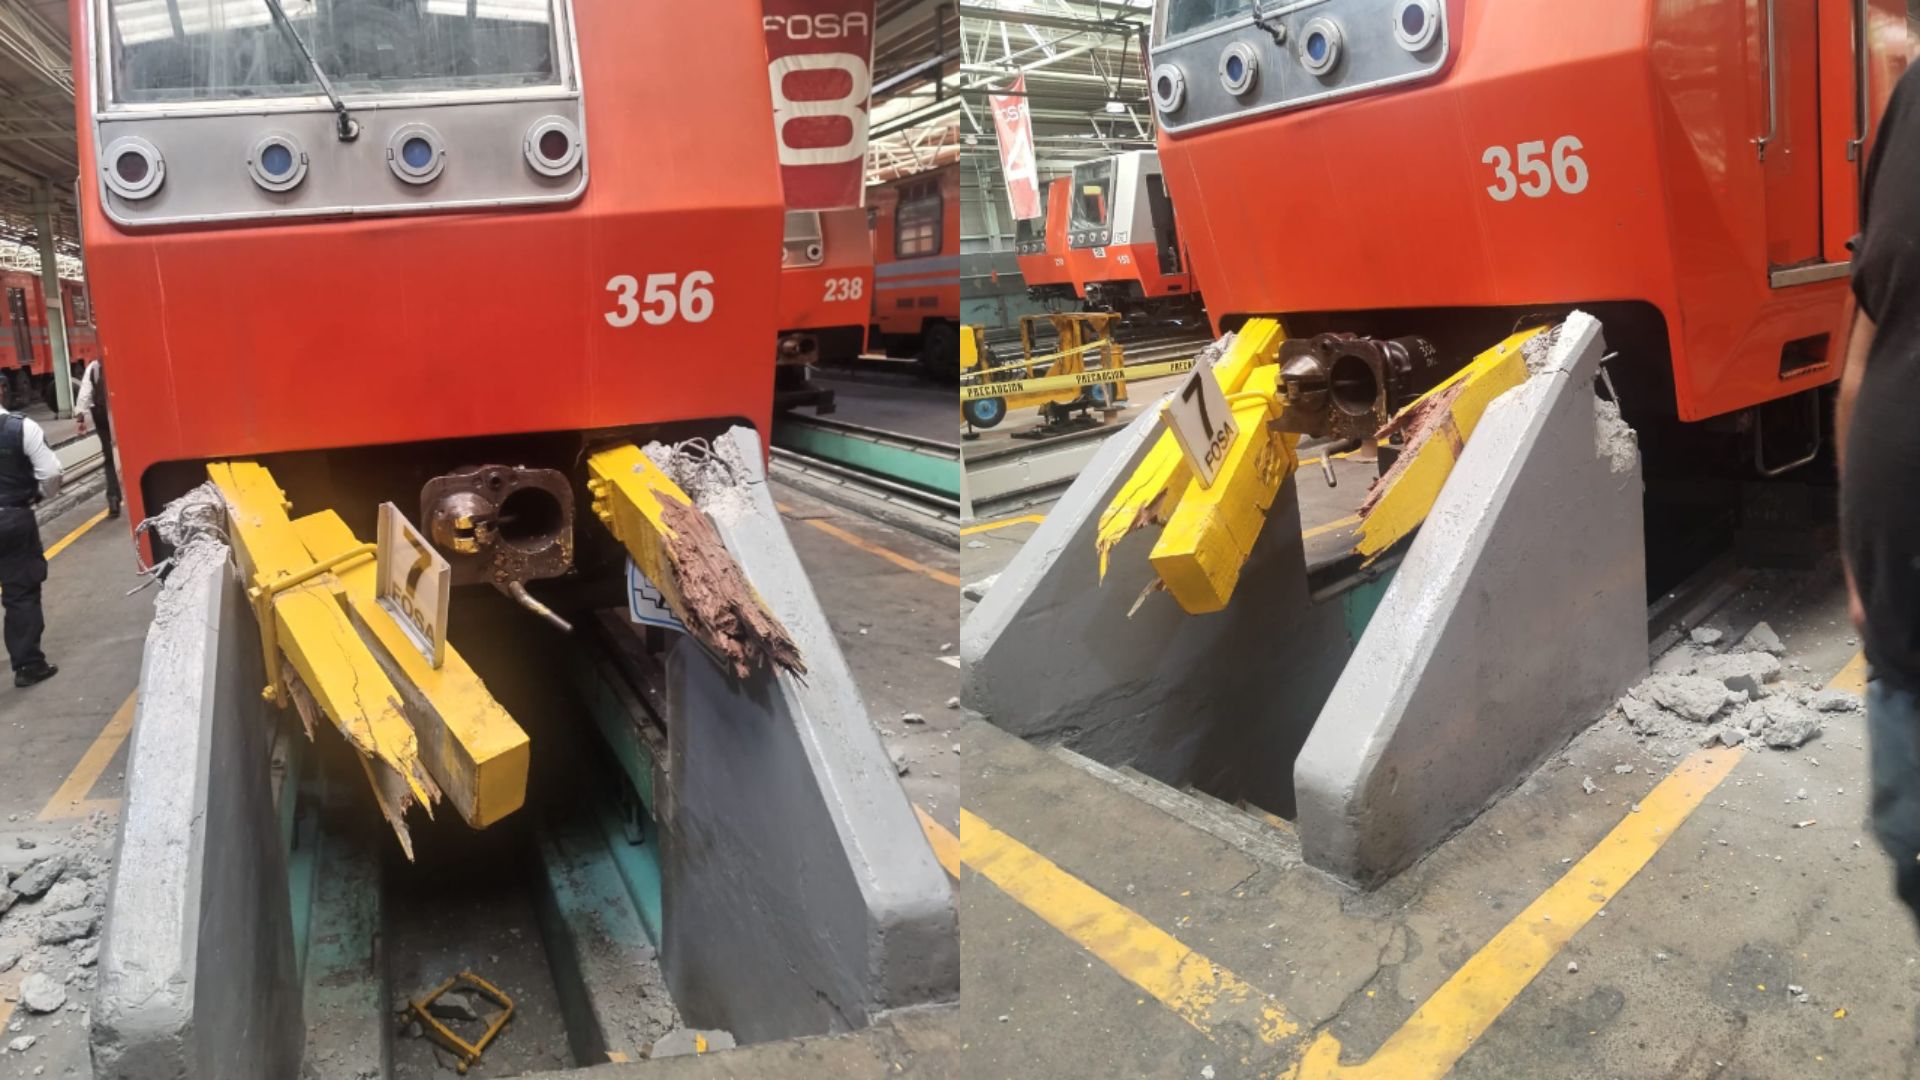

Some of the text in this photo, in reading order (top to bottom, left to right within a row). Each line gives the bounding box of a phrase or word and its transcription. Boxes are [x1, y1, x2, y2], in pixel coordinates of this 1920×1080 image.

[763, 12, 868, 39] FOSA
[768, 52, 869, 166] 8
[1482, 135, 1589, 202] 356
[604, 270, 715, 328] 356
[823, 276, 863, 302] 238
[1182, 371, 1214, 441] 7
[1205, 421, 1234, 473] FOSA
[403, 524, 432, 600] 7
[392, 581, 435, 649] FOSA
